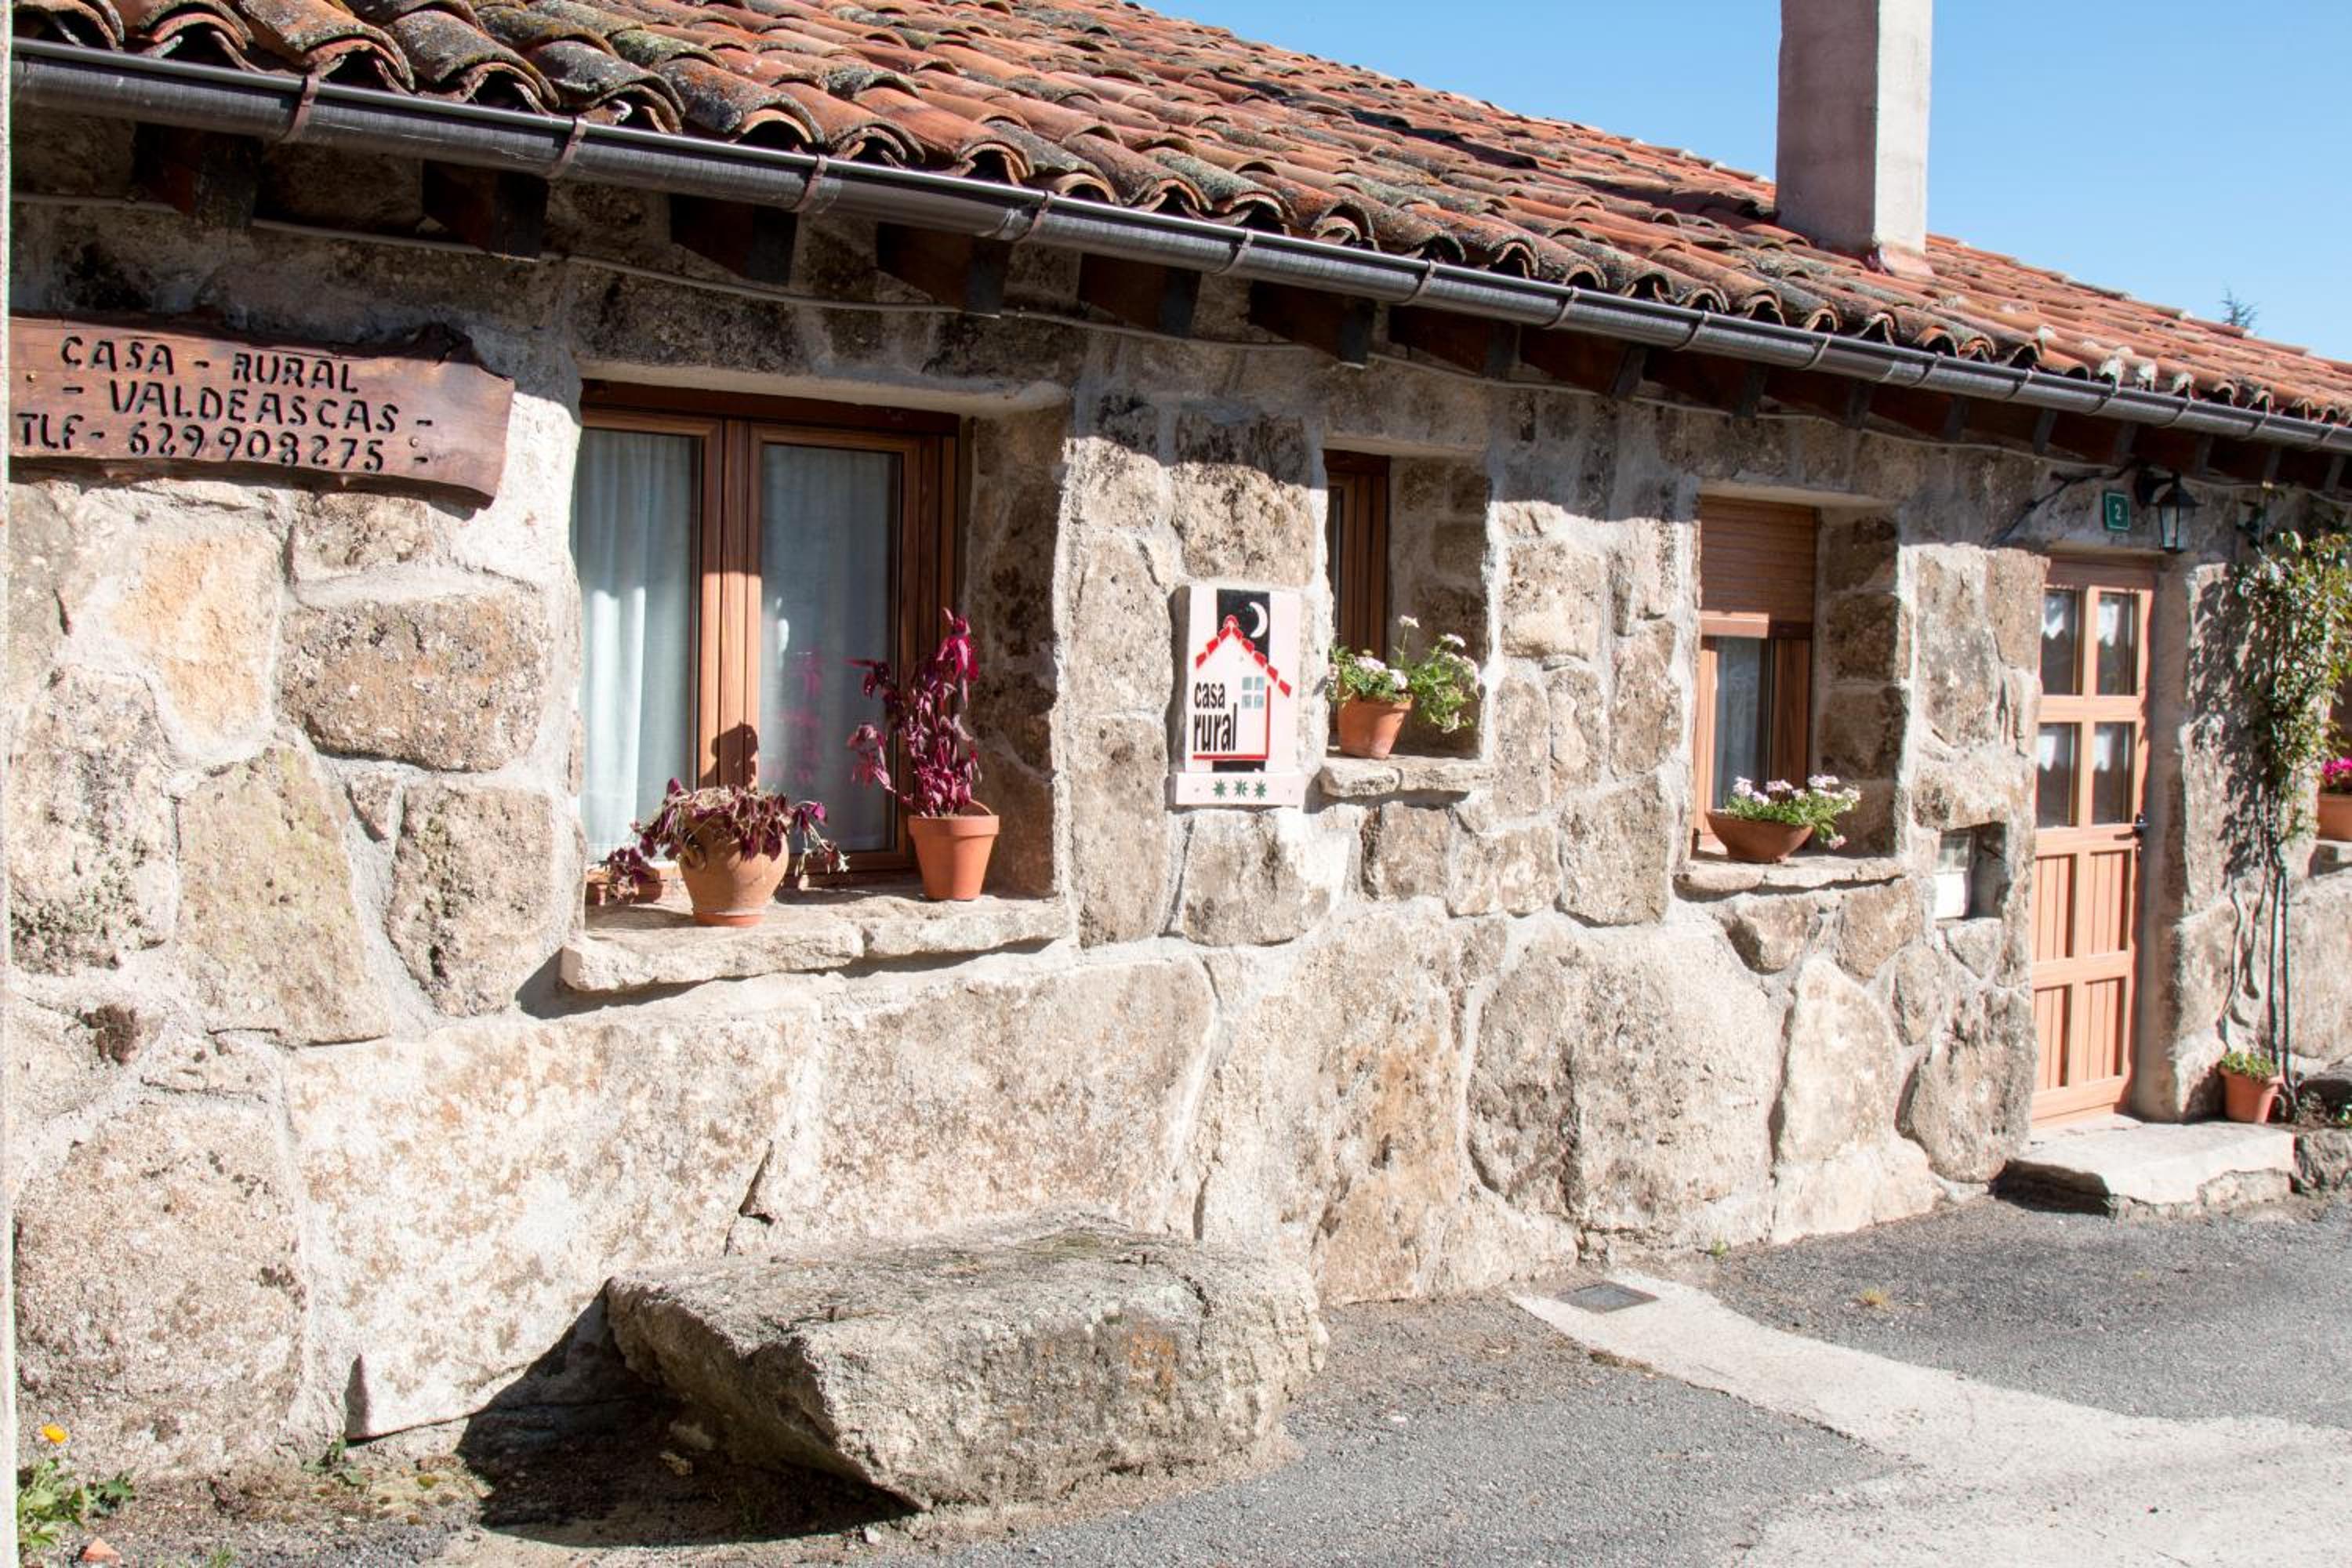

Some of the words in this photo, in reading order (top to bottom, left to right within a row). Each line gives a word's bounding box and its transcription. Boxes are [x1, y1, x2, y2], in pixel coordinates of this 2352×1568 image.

[61, 336, 174, 375] CASA
[232, 352, 359, 393] RURAL
[109, 379, 399, 433] VALDEASCAS
[2114, 503, 2122, 521] 2
[1193, 681, 1225, 710] casa
[1192, 702, 1238, 752] rural
